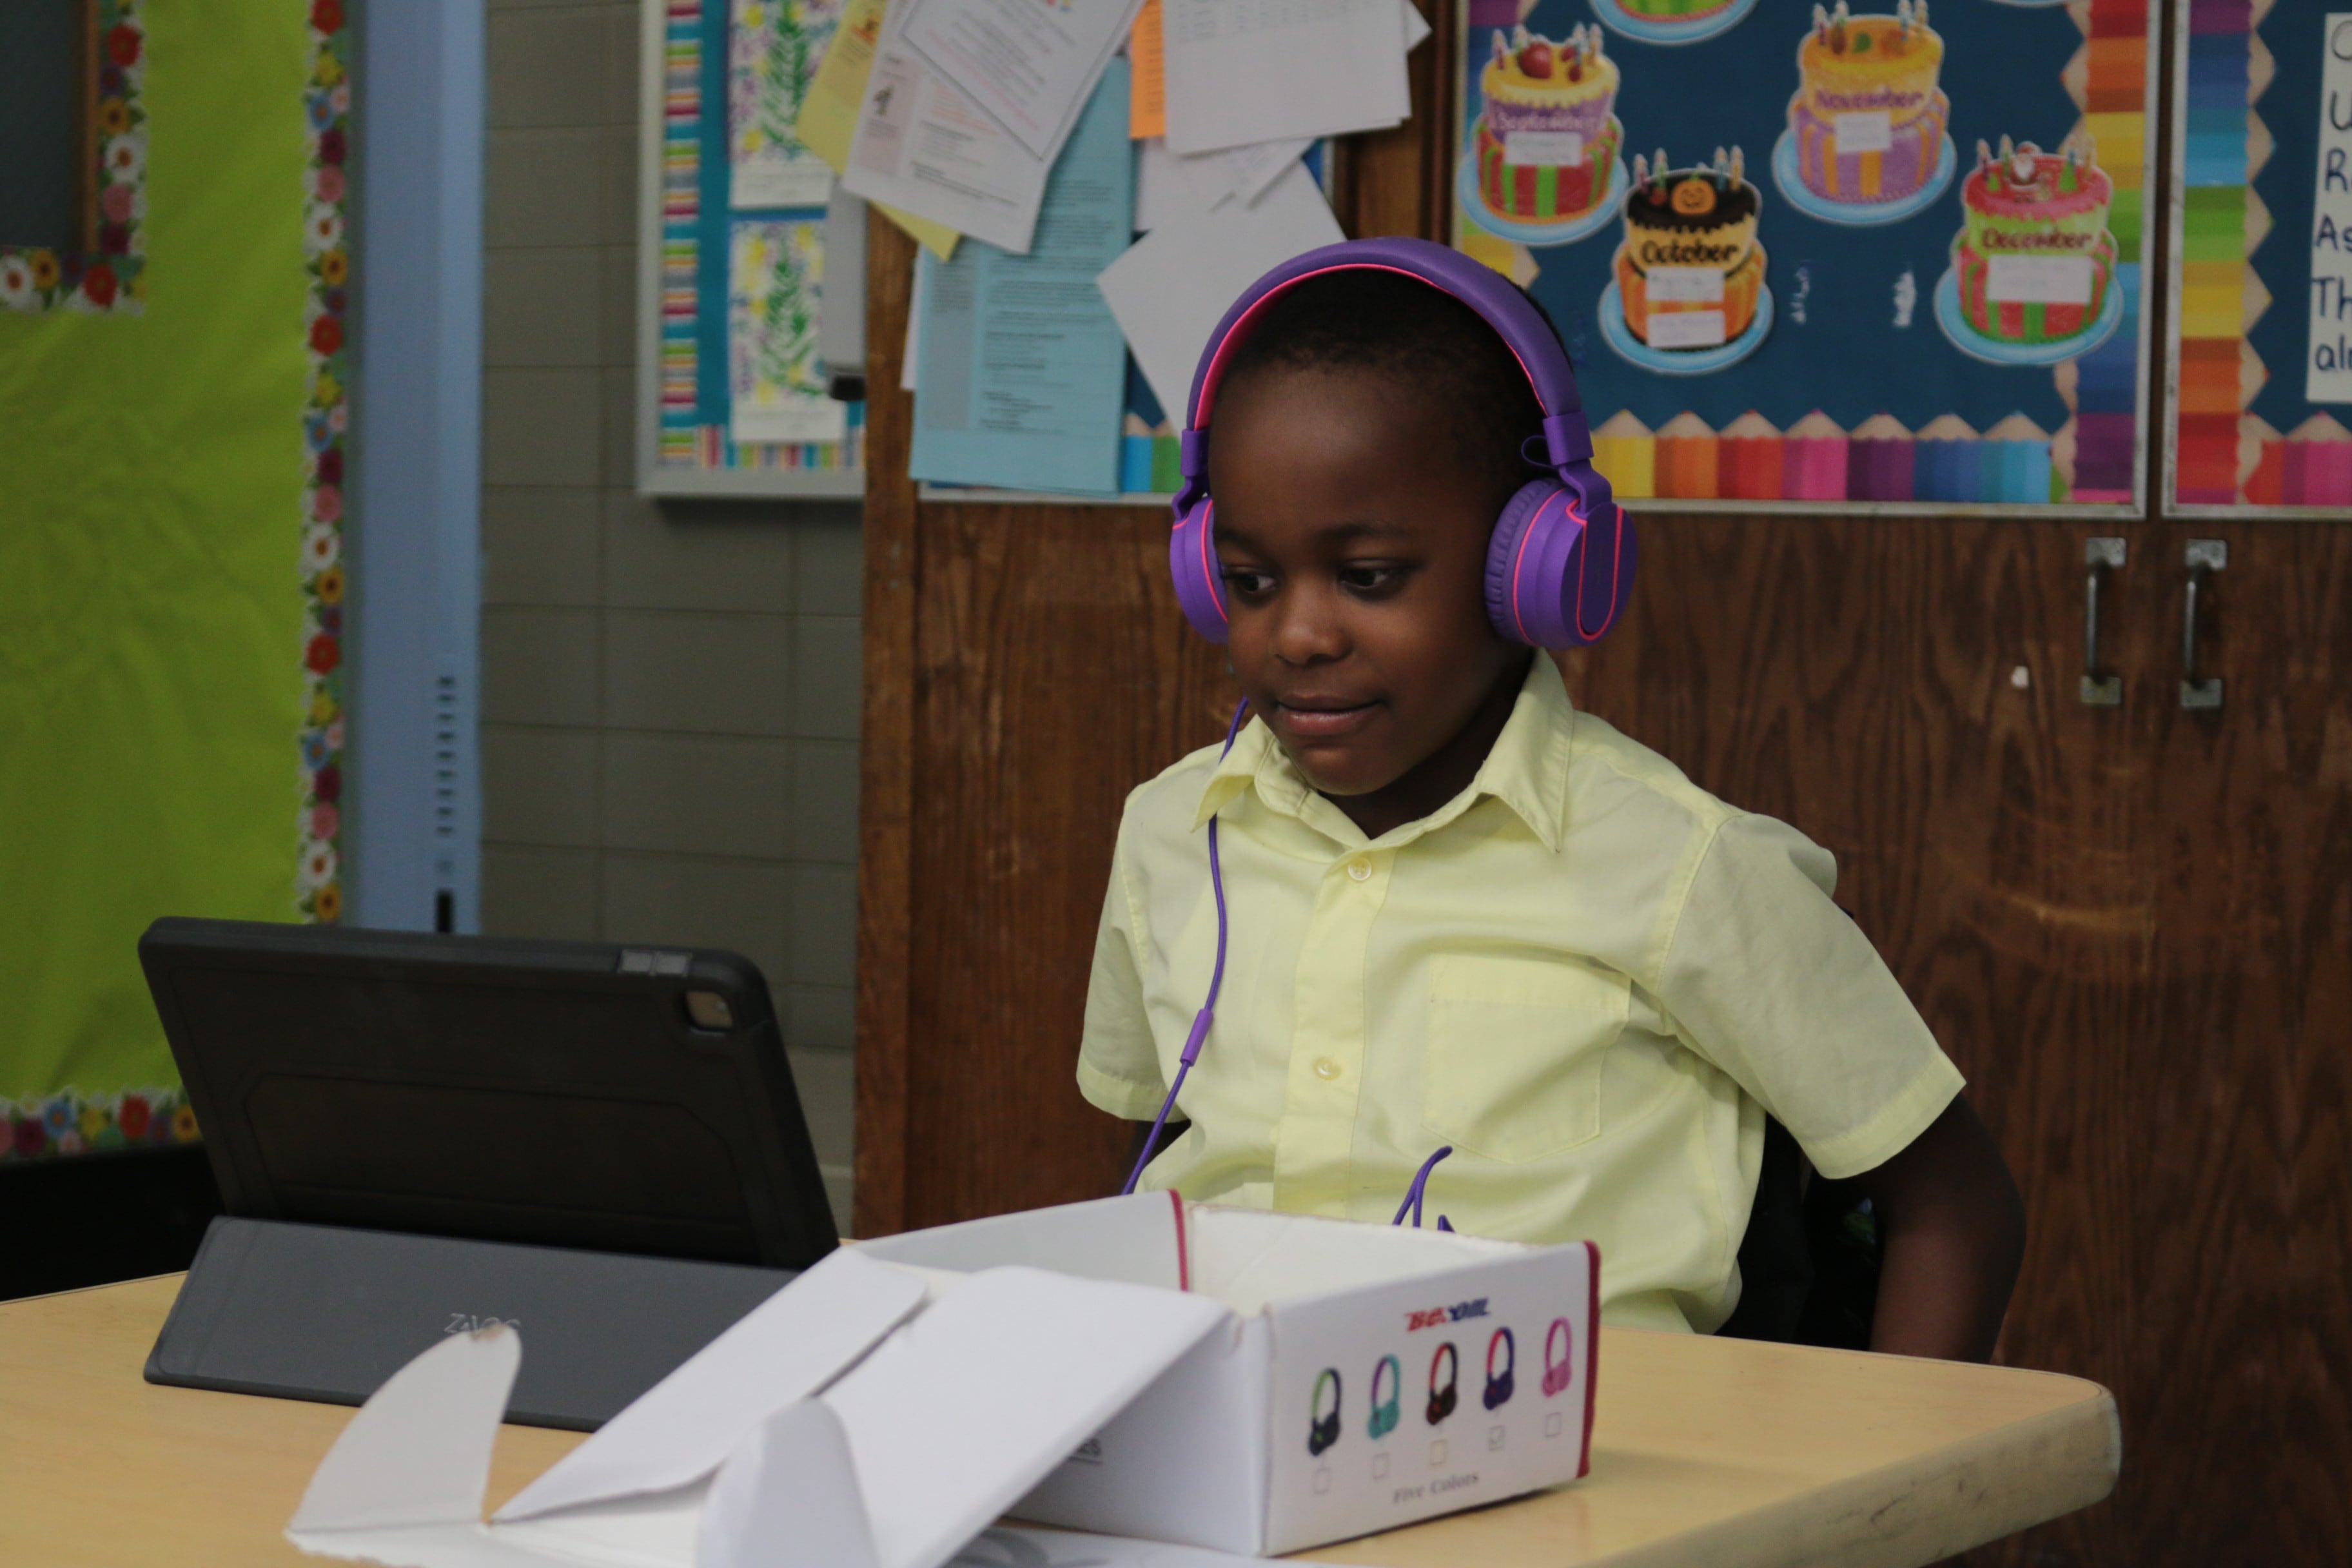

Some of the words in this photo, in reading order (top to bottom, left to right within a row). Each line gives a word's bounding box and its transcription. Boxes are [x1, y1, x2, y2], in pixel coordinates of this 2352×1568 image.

[1815, 88, 1924, 109] November
[1983, 227, 2092, 250] December
[1640, 239, 1738, 264] October
[1393, 1484, 1425, 1505] Five
[1429, 1471, 1479, 1494] Colors
